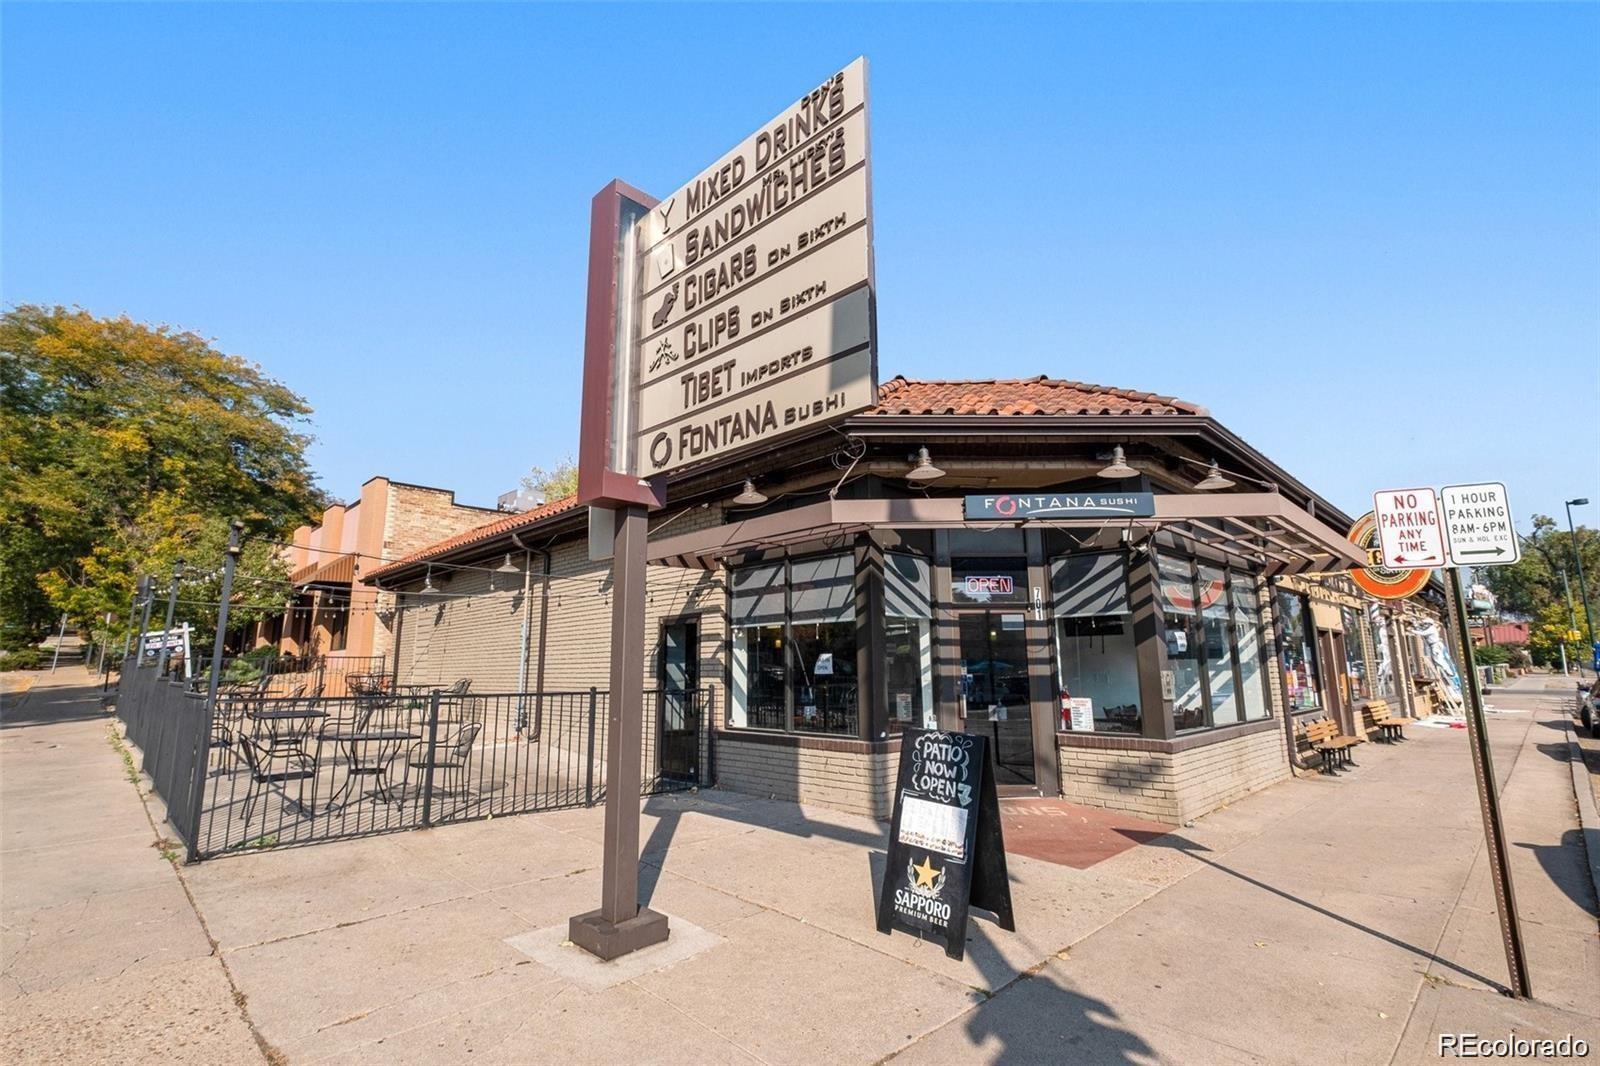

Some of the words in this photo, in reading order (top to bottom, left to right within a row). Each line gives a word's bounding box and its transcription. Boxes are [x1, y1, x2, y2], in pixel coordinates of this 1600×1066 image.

[801, 72, 844, 110] DON'S
[686, 155, 745, 220] MIXED
[755, 82, 844, 173] DRINKS
[685, 137, 846, 265] SANDWICHES
[683, 243, 757, 312] CIGARS
[767, 243, 791, 268] ON
[797, 212, 846, 251] SIXTH
[683, 304, 740, 360] CLIPS
[751, 308, 773, 329] ON
[779, 280, 826, 316] SIXTH
[681, 358, 737, 409] TIBET
[741, 345, 813, 388] IMPORTS
[679, 400, 778, 461] FONTANA
[784, 392, 845, 426] SUSHI
[984, 496, 1097, 516] FONTANA
[1393, 494, 1417, 510] NO
[1461, 491, 1497, 504] HOUR
[1381, 510, 1436, 528] PARKING
[1449, 506, 1505, 520] PARKING
[1399, 528, 1423, 540] ANY
[1453, 536, 1466, 544] SUN
[1477, 535, 1490, 543] HOL
[1494, 534, 1508, 542] EXC
[1398, 541, 1427, 553] TIME
[967, 577, 1012, 593] OPEN
[1034, 588, 1043, 620] 701
[923, 741, 963, 762] PATIO
[924, 760, 957, 779] NOW
[920, 775, 956, 798] OPEN
[894, 889, 951, 920] SAPPORO
[894, 904, 928, 921] PREMIUM
[929, 916, 949, 928] BEER
